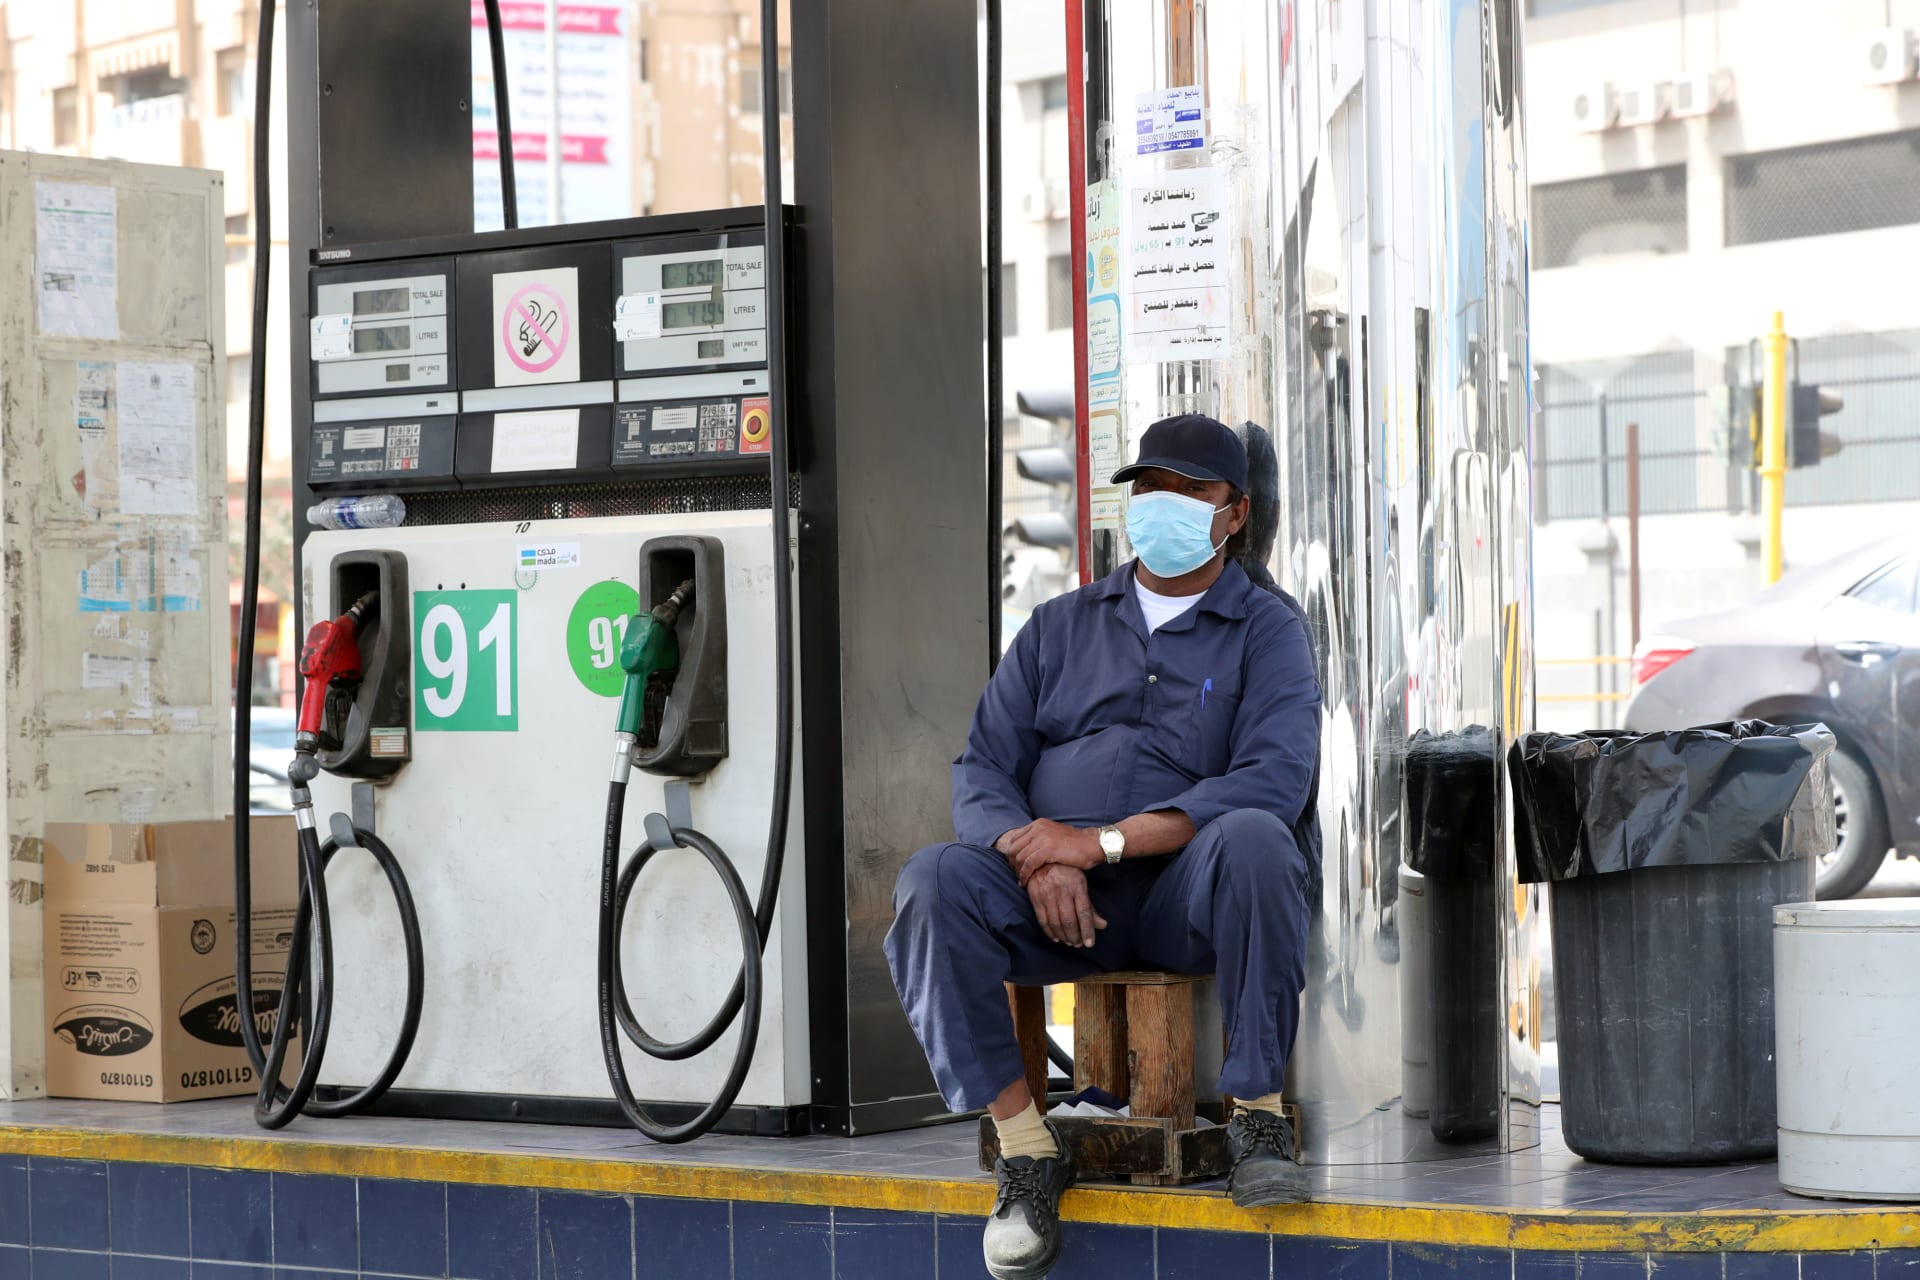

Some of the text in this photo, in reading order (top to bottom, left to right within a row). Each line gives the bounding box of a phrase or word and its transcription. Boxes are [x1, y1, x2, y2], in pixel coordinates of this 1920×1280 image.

[1143, 190, 1165, 204] الكرام
[1175, 236, 1184, 246] 91
[1189, 236, 1213, 247] بنزين
[318, 249, 351, 261] TATSUNO
[726, 262, 745, 271] TOTAL
[1176, 262, 1190, 274] على
[1193, 261, 1214, 273] تحصل
[412, 290, 444, 299] TOTAL SALE
[734, 305, 756, 314] LITRES
[418, 332, 438, 340] LITRES
[514, 522, 530, 534] 10
[537, 548, 556, 556] مدى
[537, 557, 556, 565] mada
[420, 603, 512, 718] 91
[78, 1024, 134, 1052] كلينكس
[101, 1072, 153, 1086] G1101870
[181, 1066, 252, 1088] G1101870
